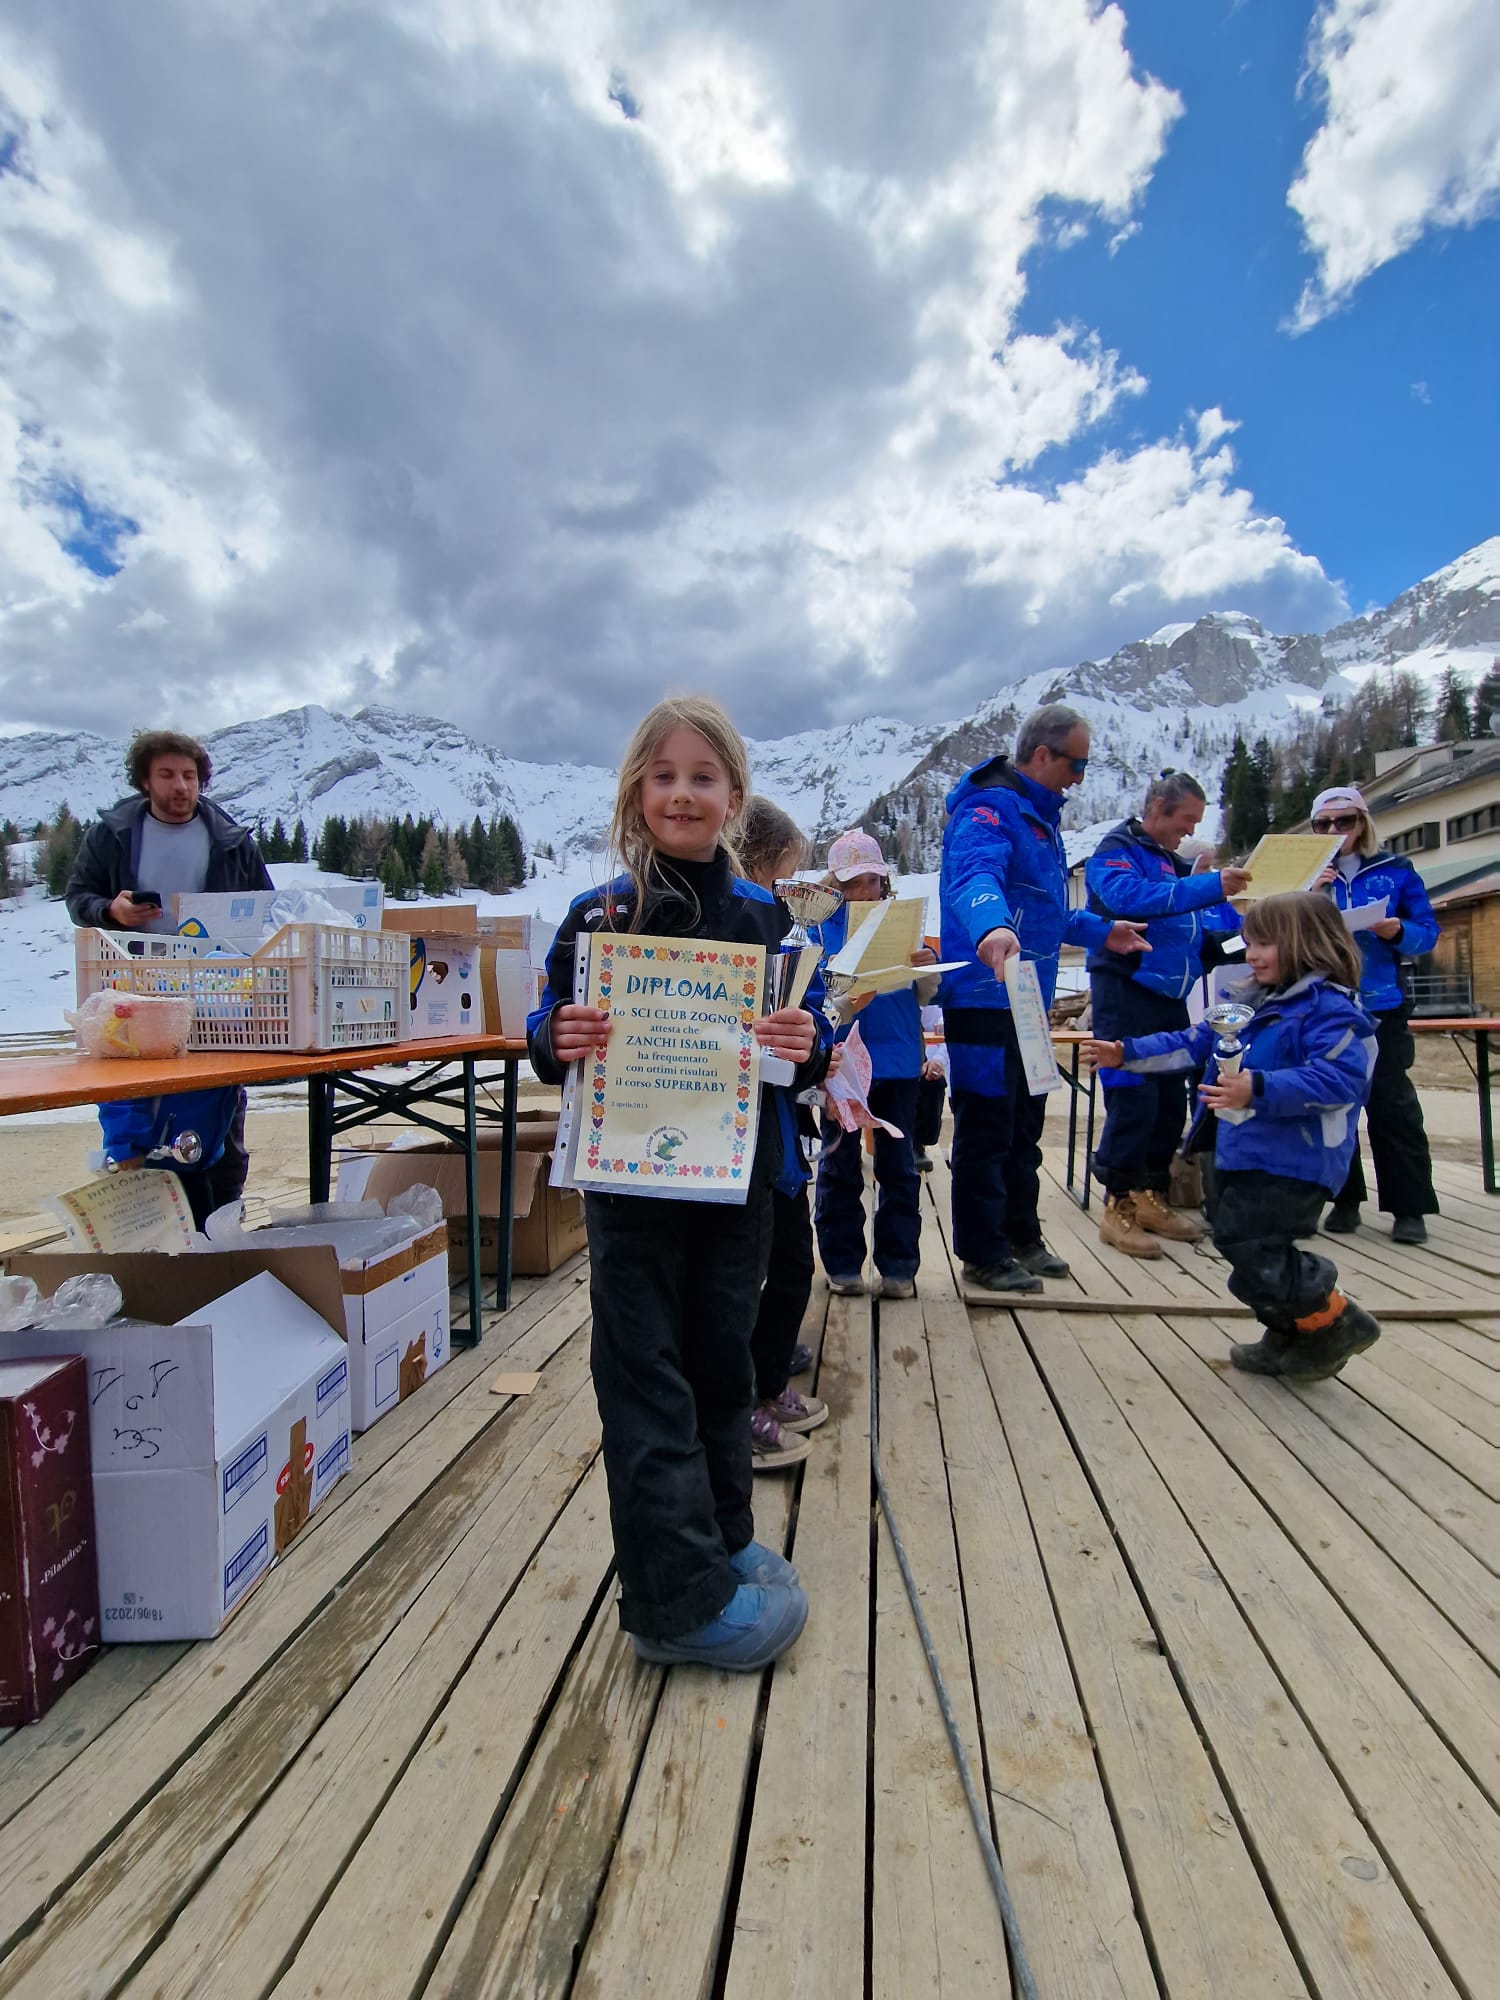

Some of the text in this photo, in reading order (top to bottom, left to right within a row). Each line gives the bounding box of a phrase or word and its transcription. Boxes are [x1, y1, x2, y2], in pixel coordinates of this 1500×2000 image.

[626, 975, 728, 1001] DIPLOMA
[613, 1007, 738, 1025] Lo SCI CLUB ZOGNO
[650, 1024, 700, 1034] attesta che
[626, 1035, 721, 1051] ZANCHI ISABEL
[637, 1050, 709, 1064] ha frequentato
[626, 1064, 719, 1077] con ottimi risultati
[615, 1077, 727, 1093] il corso SUPERBABY
[88, 1171, 150, 1200] DIPLOMA
